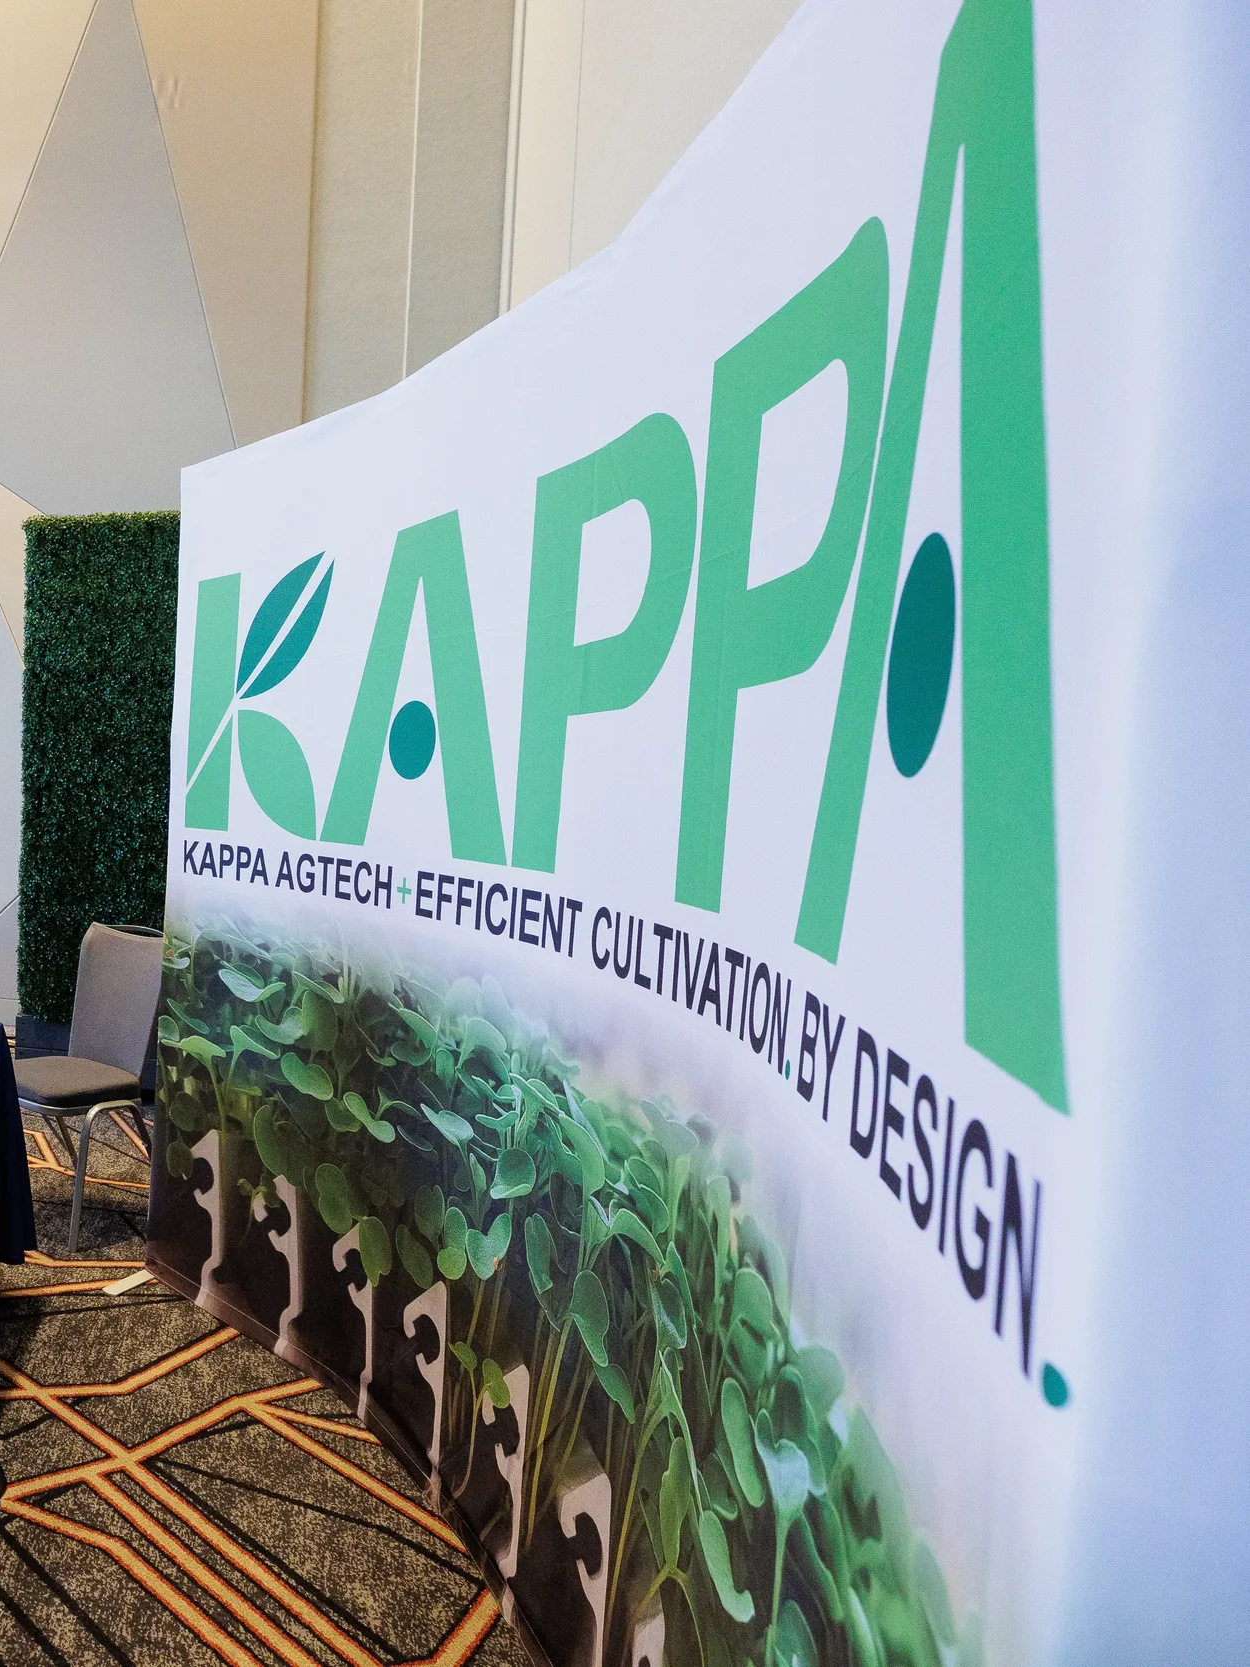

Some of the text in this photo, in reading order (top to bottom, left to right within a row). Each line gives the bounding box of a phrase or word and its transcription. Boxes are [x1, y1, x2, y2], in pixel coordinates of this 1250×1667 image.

[184, 0, 1072, 1117] KAPPA
[183, 839, 269, 886] KAPPA
[796, 990, 846, 1123] BY
[849, 1026, 1071, 1409] DESIGN.
